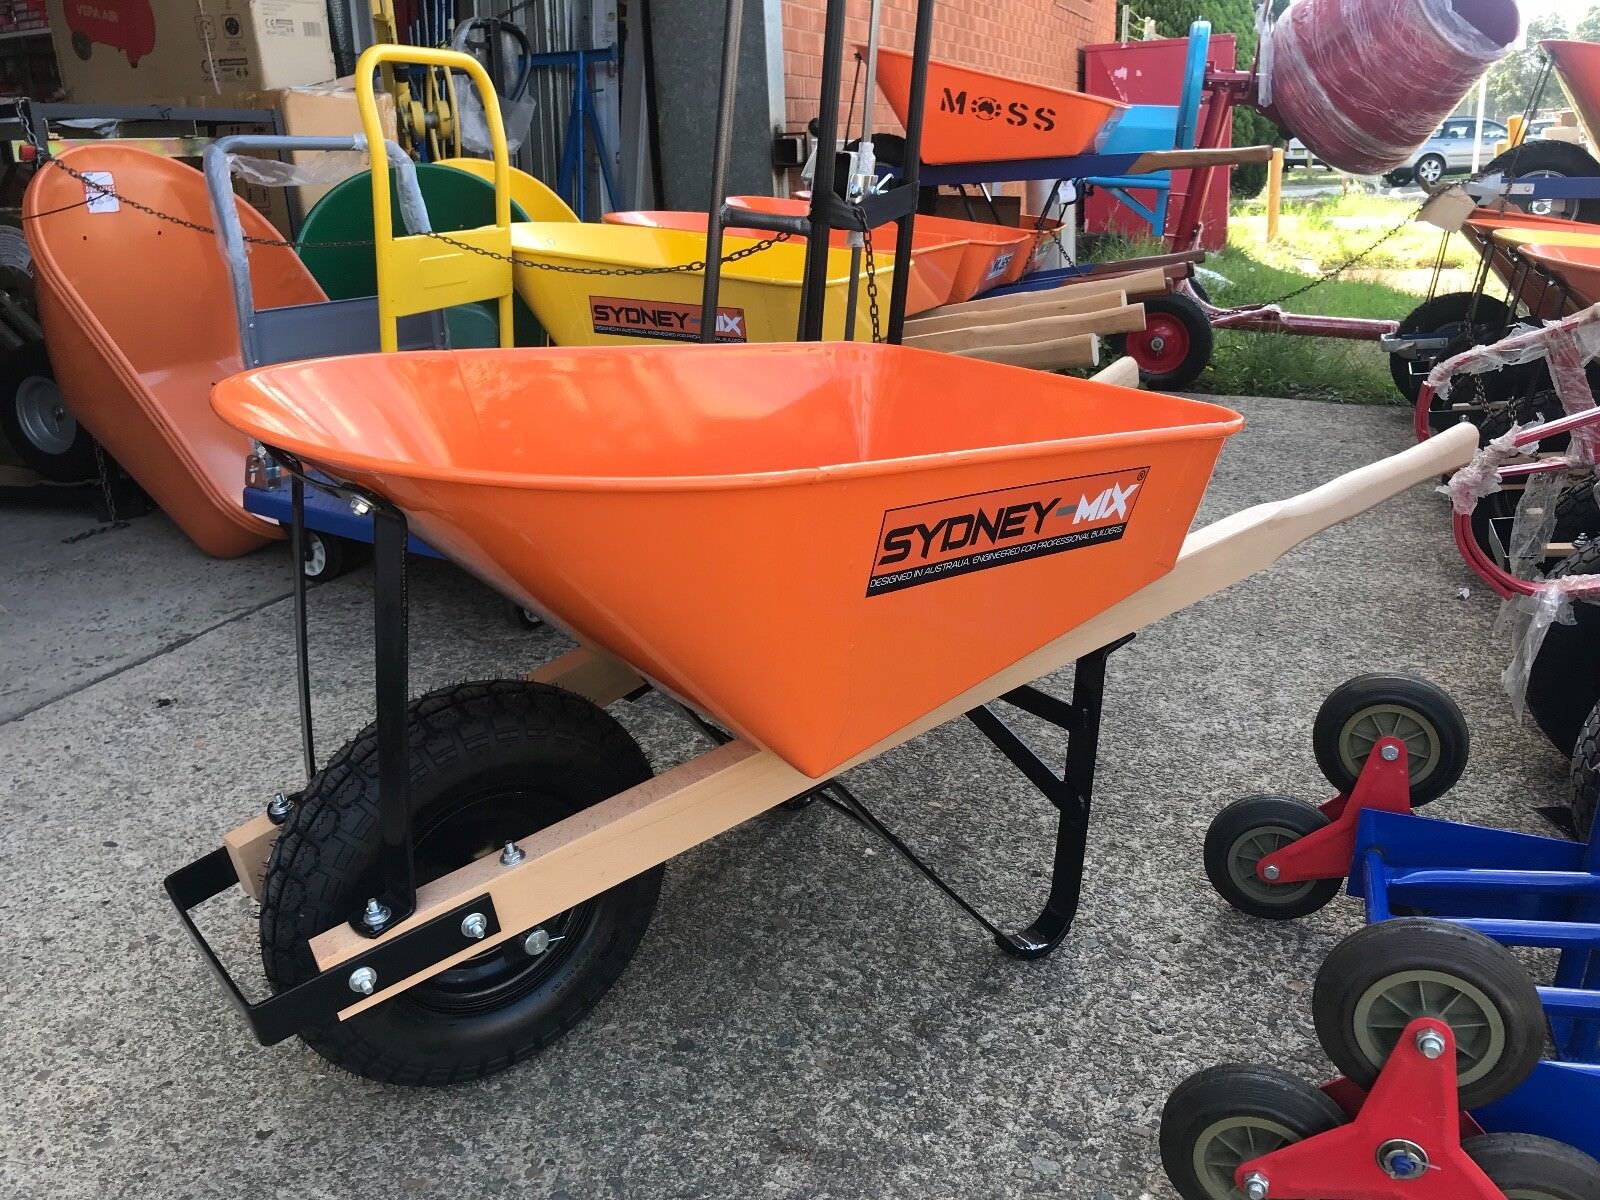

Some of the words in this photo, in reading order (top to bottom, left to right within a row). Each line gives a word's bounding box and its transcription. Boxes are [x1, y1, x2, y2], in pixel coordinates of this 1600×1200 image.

[940, 87, 1057, 132] MOSS
[593, 304, 742, 337] SYDNEY-IX
[869, 571, 913, 588] DESIGNED
[913, 568, 924, 579] IN
[972, 546, 1021, 564] ENGINEERED
[1020, 543, 1037, 554] FOR
[1036, 531, 1090, 550] PROFESSIONAL
[1090, 525, 1124, 539] BUILDERS
